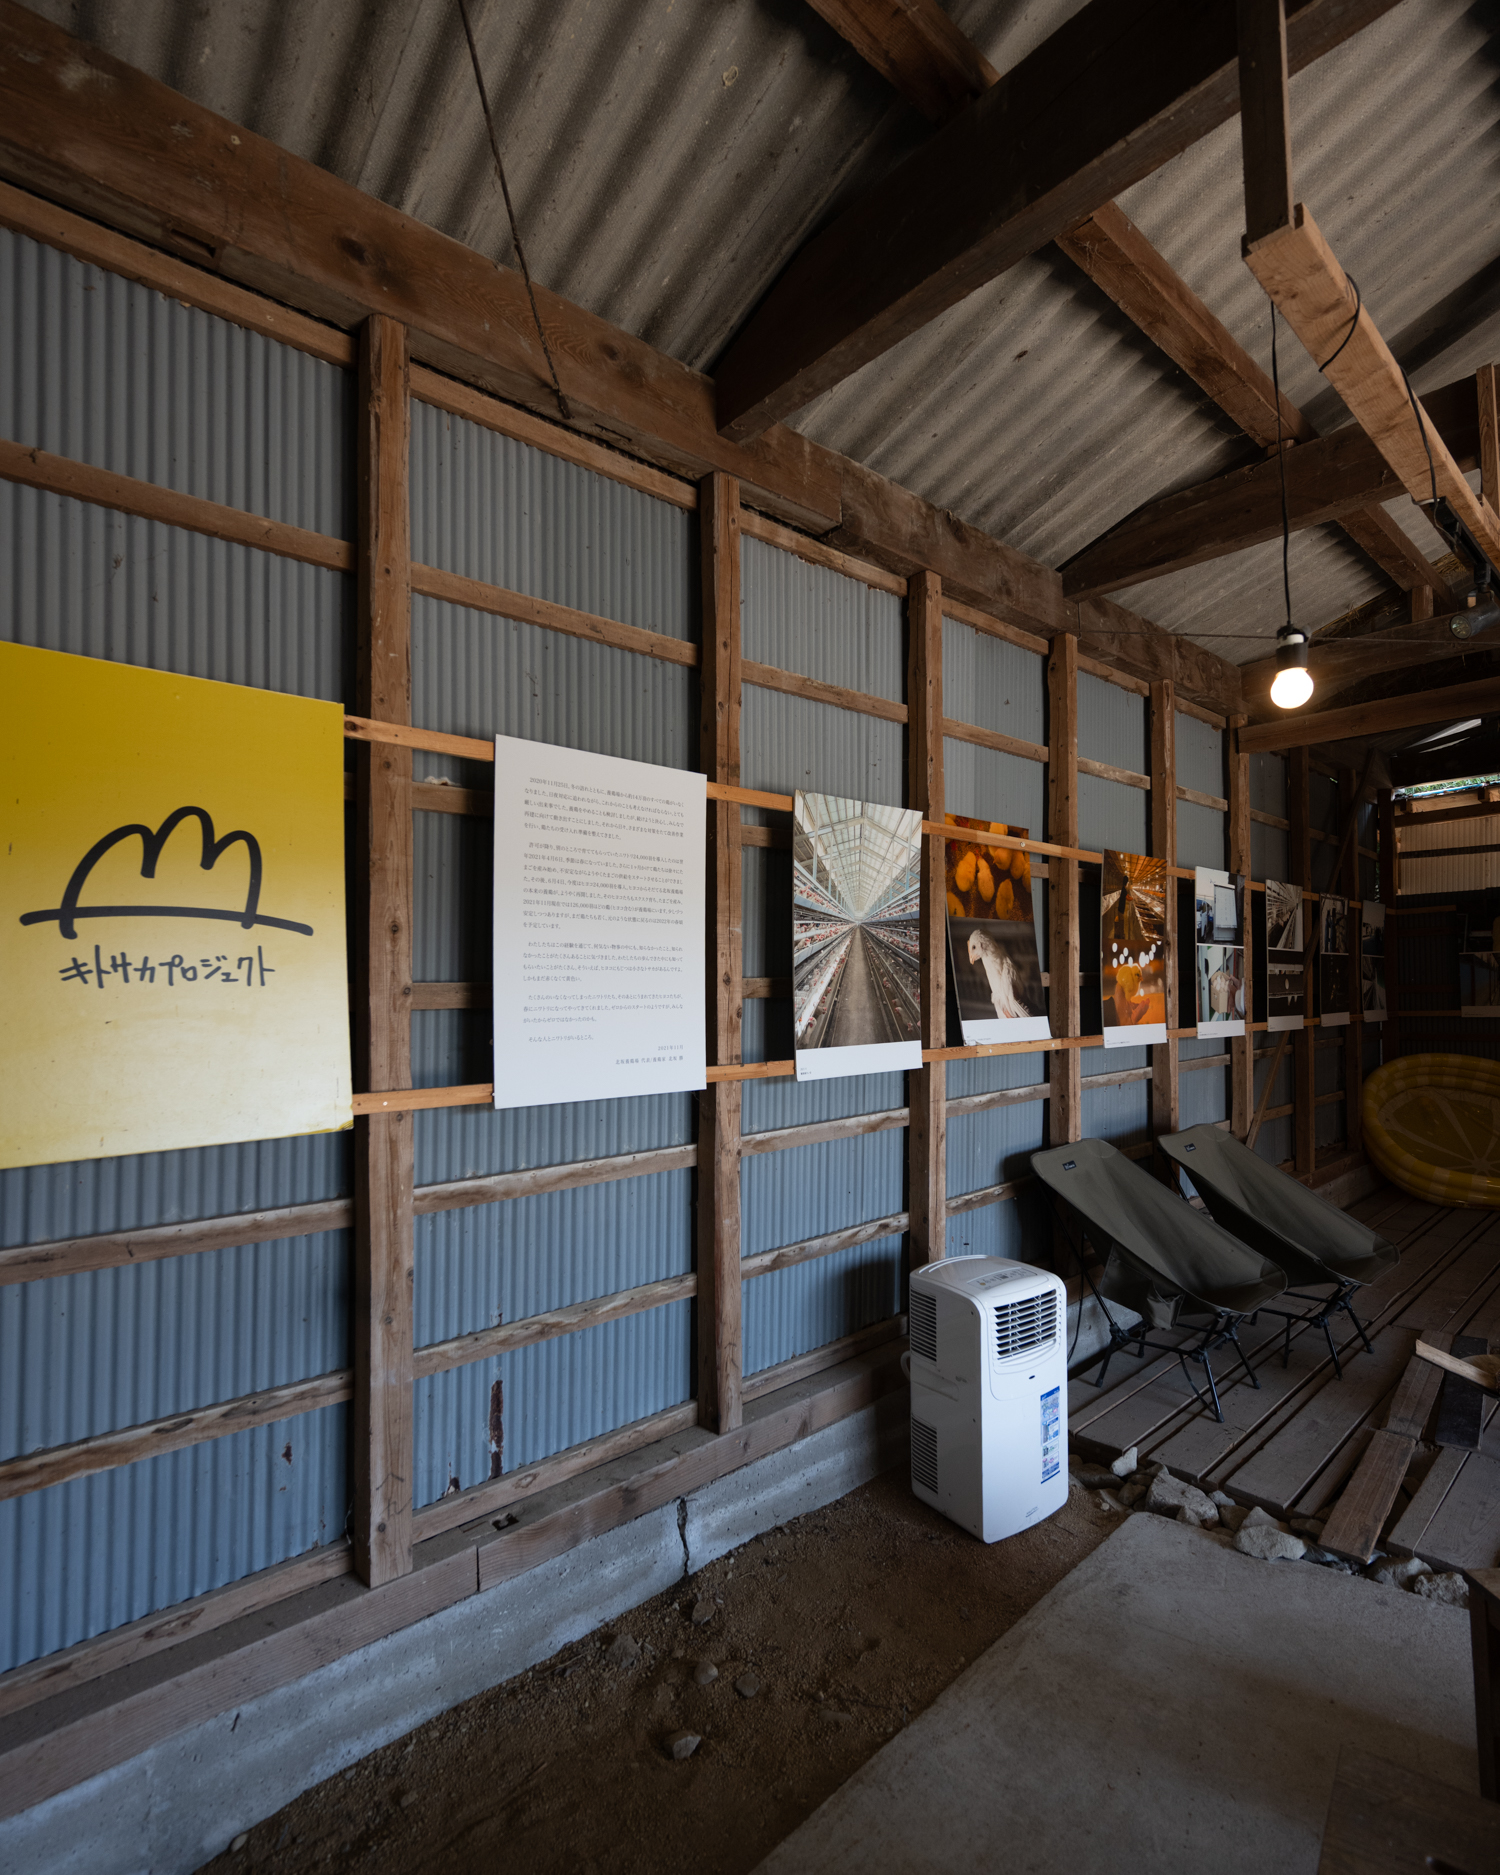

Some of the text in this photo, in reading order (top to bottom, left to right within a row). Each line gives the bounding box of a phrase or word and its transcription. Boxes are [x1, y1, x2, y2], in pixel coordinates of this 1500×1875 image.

[522, 921, 562, 930] を予定しています。
[59, 944, 275, 989] キトサカプロジェクト
